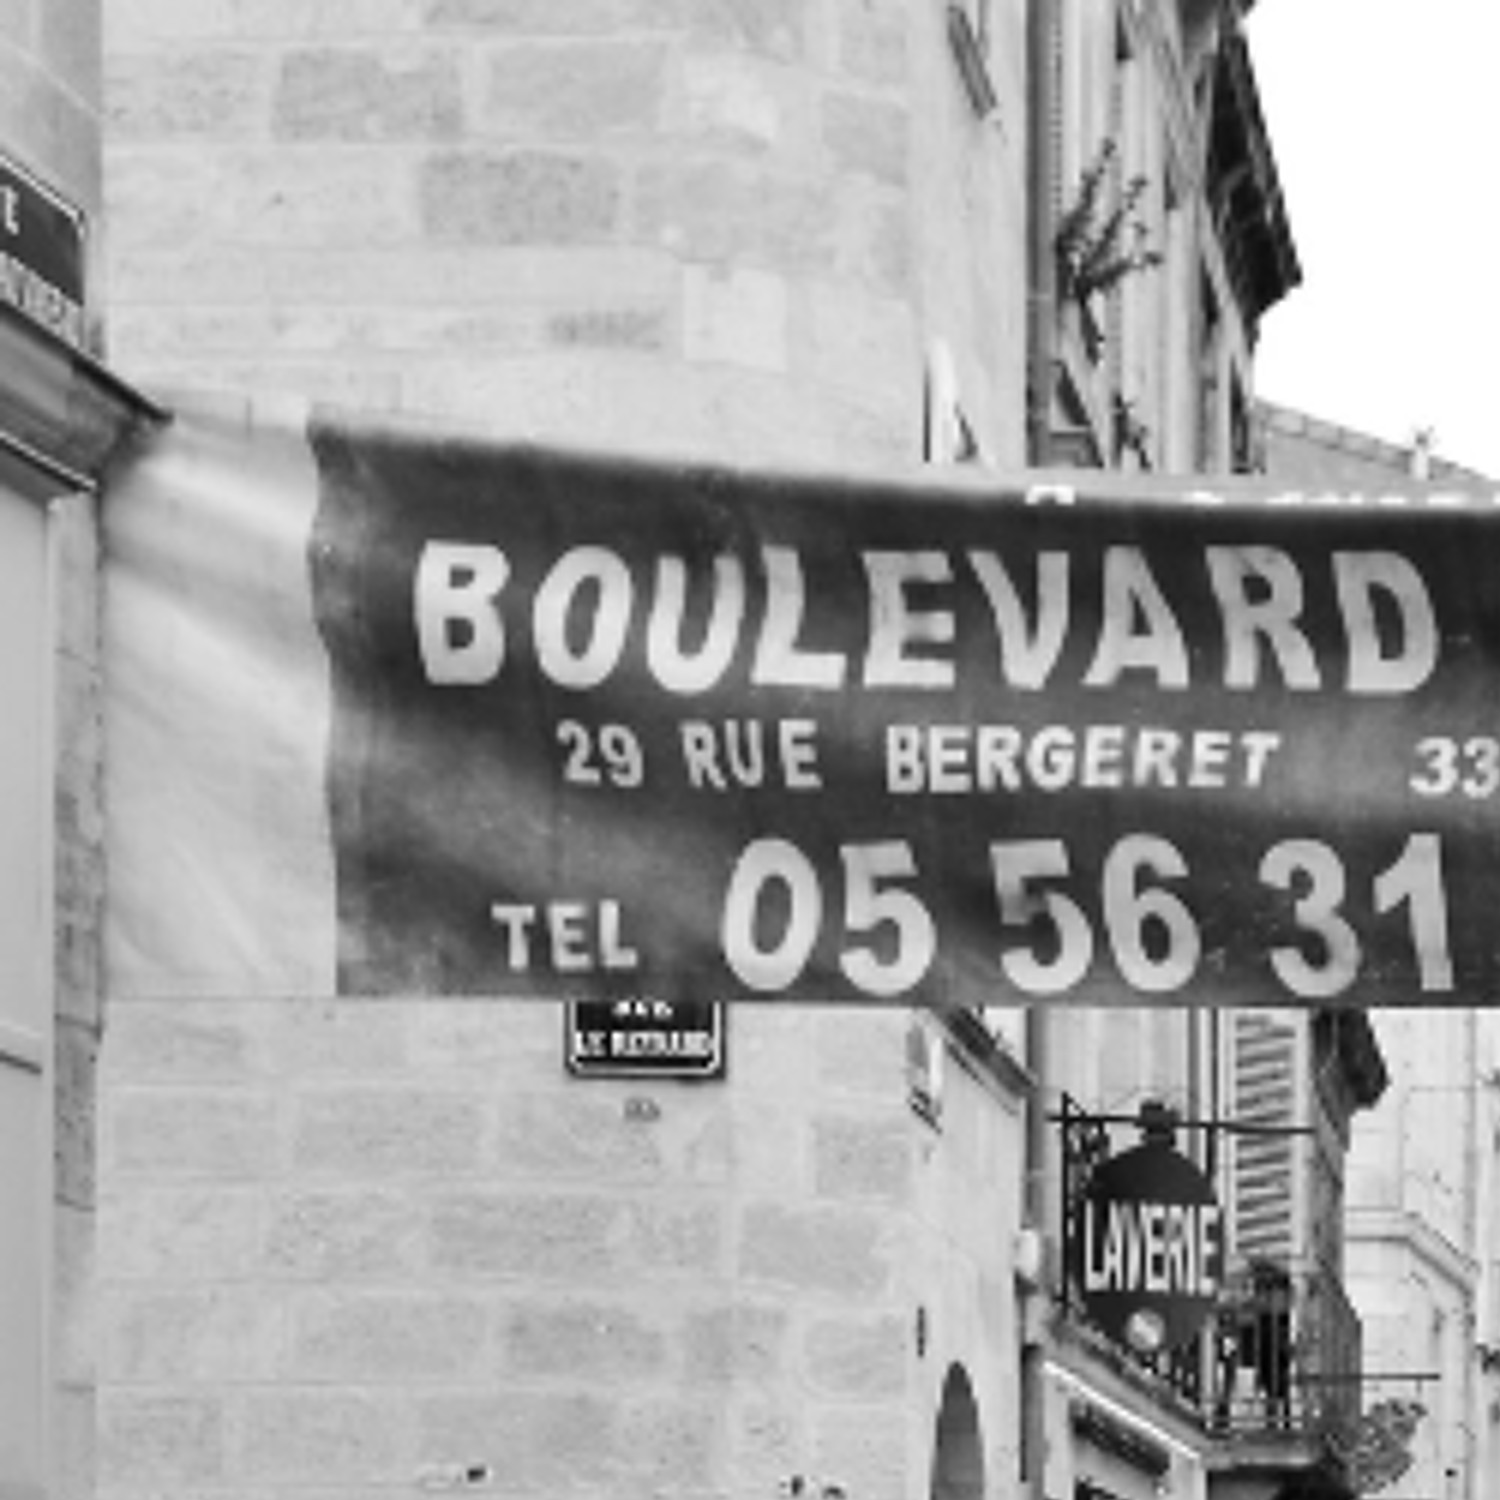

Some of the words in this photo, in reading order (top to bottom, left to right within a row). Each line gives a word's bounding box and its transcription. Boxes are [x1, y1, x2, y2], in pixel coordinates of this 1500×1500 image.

[414, 538, 1439, 694] BOULEVARD
[556, 718, 644, 788] 29
[679, 718, 823, 789] RUE
[886, 723, 1281, 794] BERGERET
[490, 899, 639, 971] TEL
[720, 837, 937, 996] 05
[989, 833, 1200, 996] 56
[1085, 1199, 1219, 1297] LAVERIE
